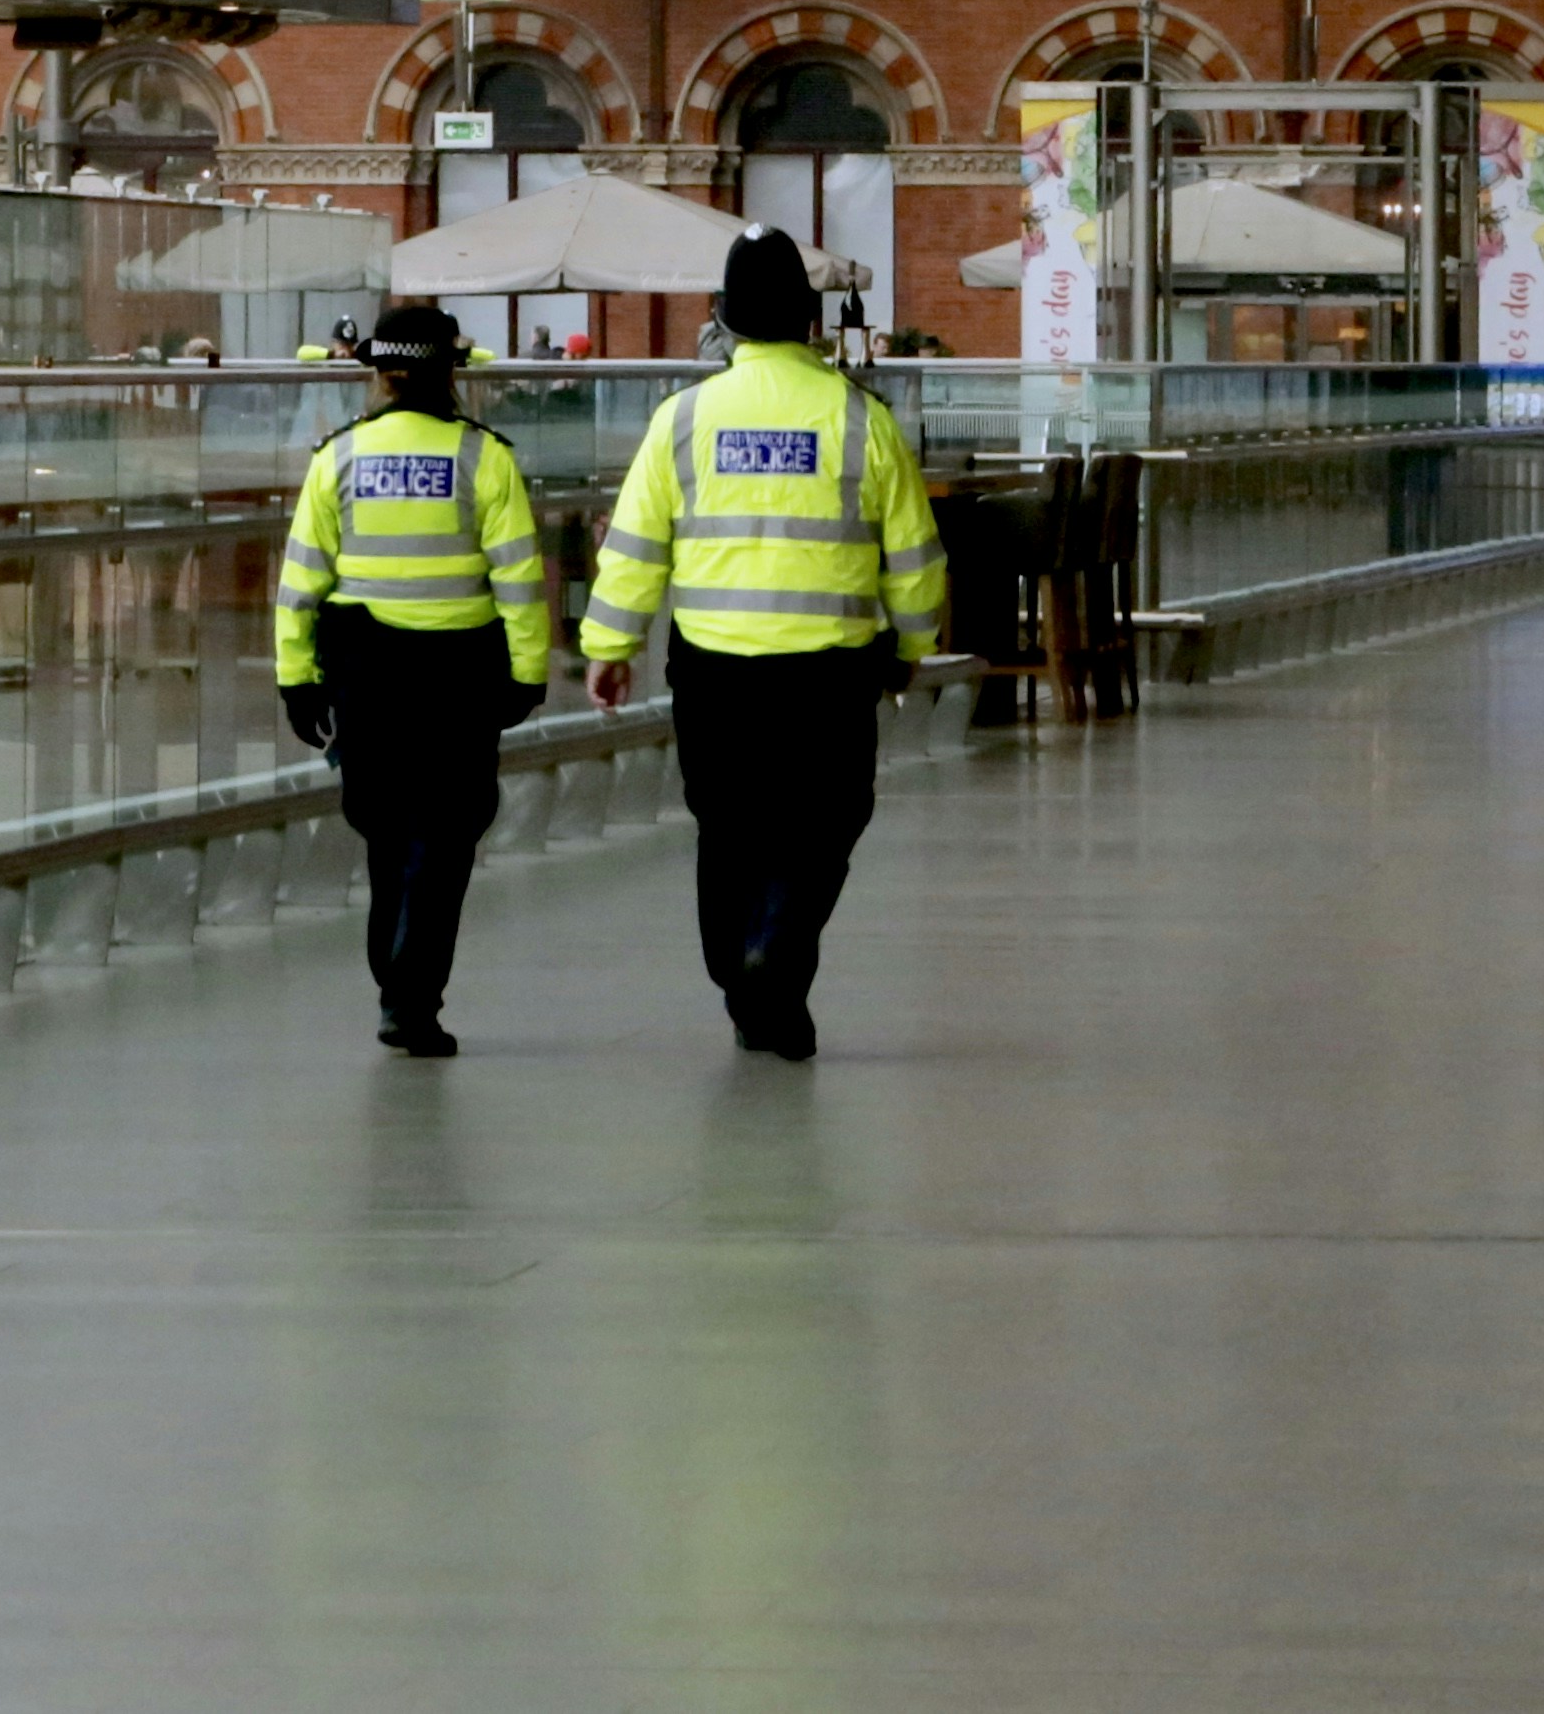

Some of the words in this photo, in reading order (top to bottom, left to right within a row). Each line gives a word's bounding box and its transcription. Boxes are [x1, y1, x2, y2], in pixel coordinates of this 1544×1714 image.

[1041, 271, 1077, 317] day
[1500, 272, 1537, 319] day
[720, 446, 813, 472] POLICE
[359, 470, 447, 496] POLICE
